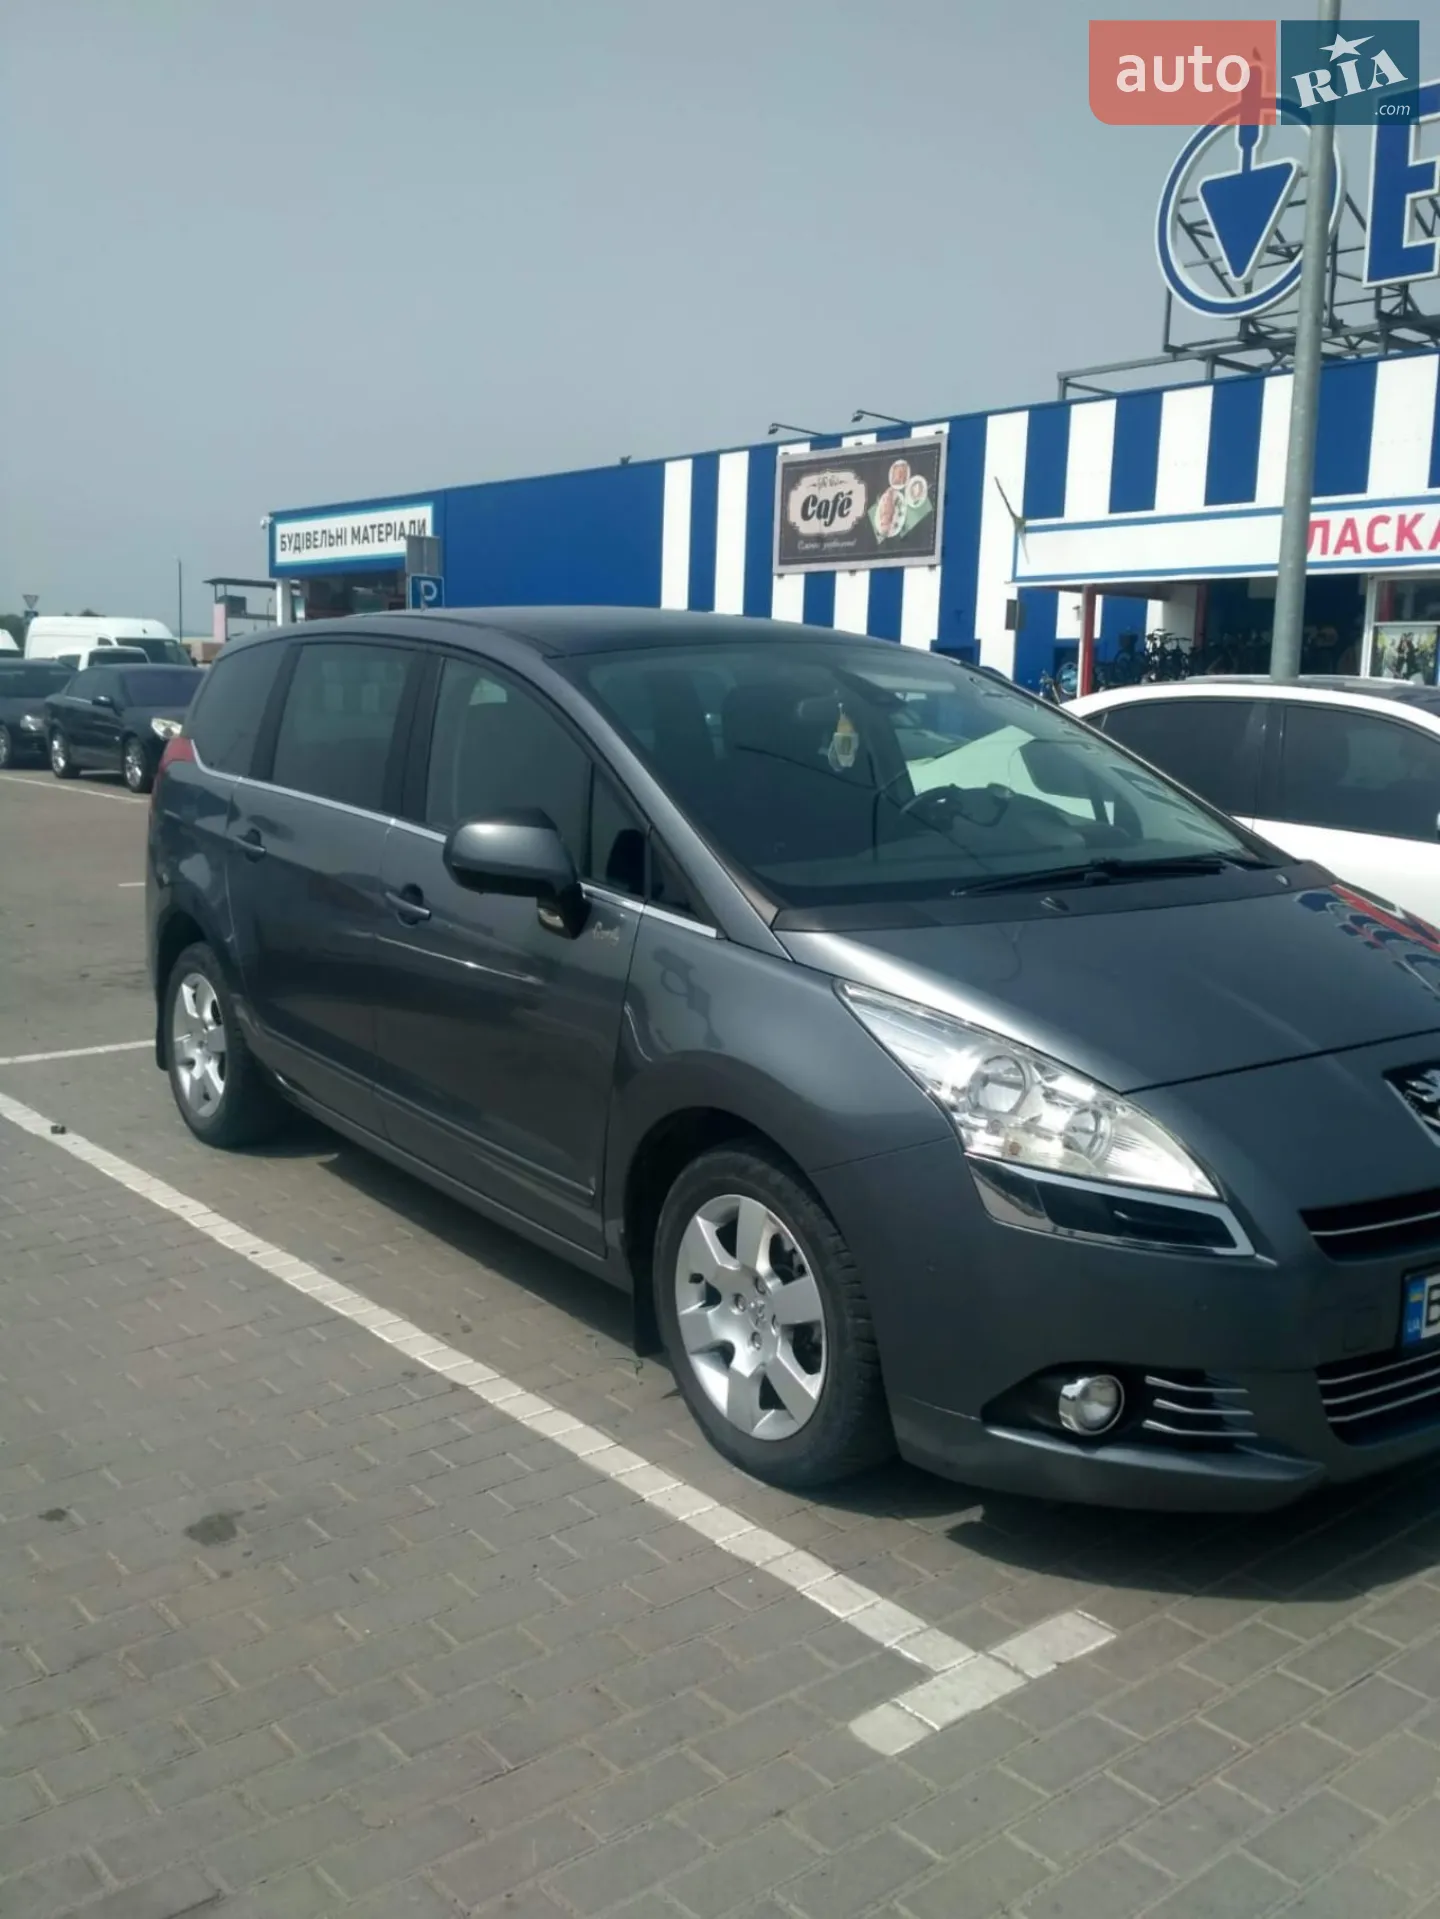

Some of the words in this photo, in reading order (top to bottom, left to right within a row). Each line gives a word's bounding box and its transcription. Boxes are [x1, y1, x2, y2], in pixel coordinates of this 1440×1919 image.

[800, 490, 854, 527] Café
[280, 529, 348, 553] БУДІВЕЛЬНІ
[350, 518, 427, 545] МАТЕРІАЛИ
